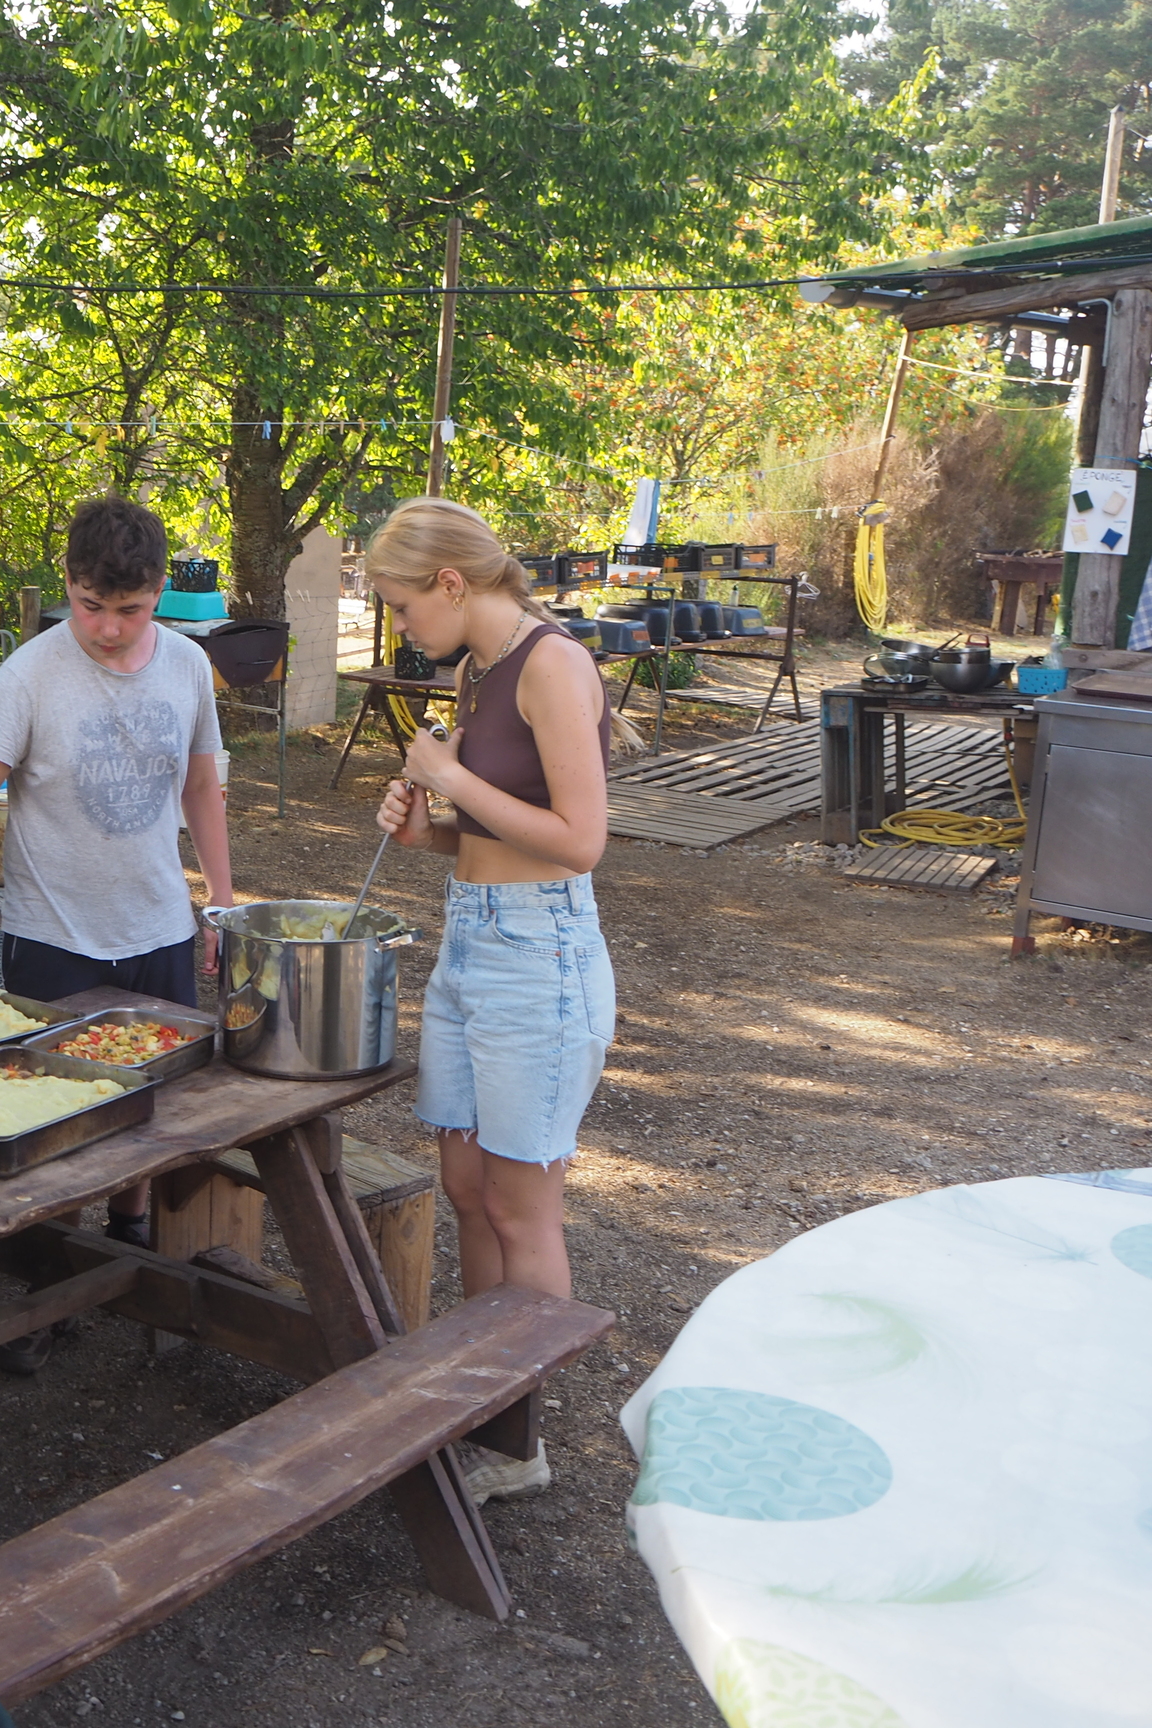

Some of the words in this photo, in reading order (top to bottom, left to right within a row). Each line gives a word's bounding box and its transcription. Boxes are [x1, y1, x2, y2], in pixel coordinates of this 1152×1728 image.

[78, 752, 180, 787] NAVAJOS
[86, 796, 120, 829] NORTH
[124, 788, 167, 831] AMERICA
[106, 783, 152, 803] 1789
